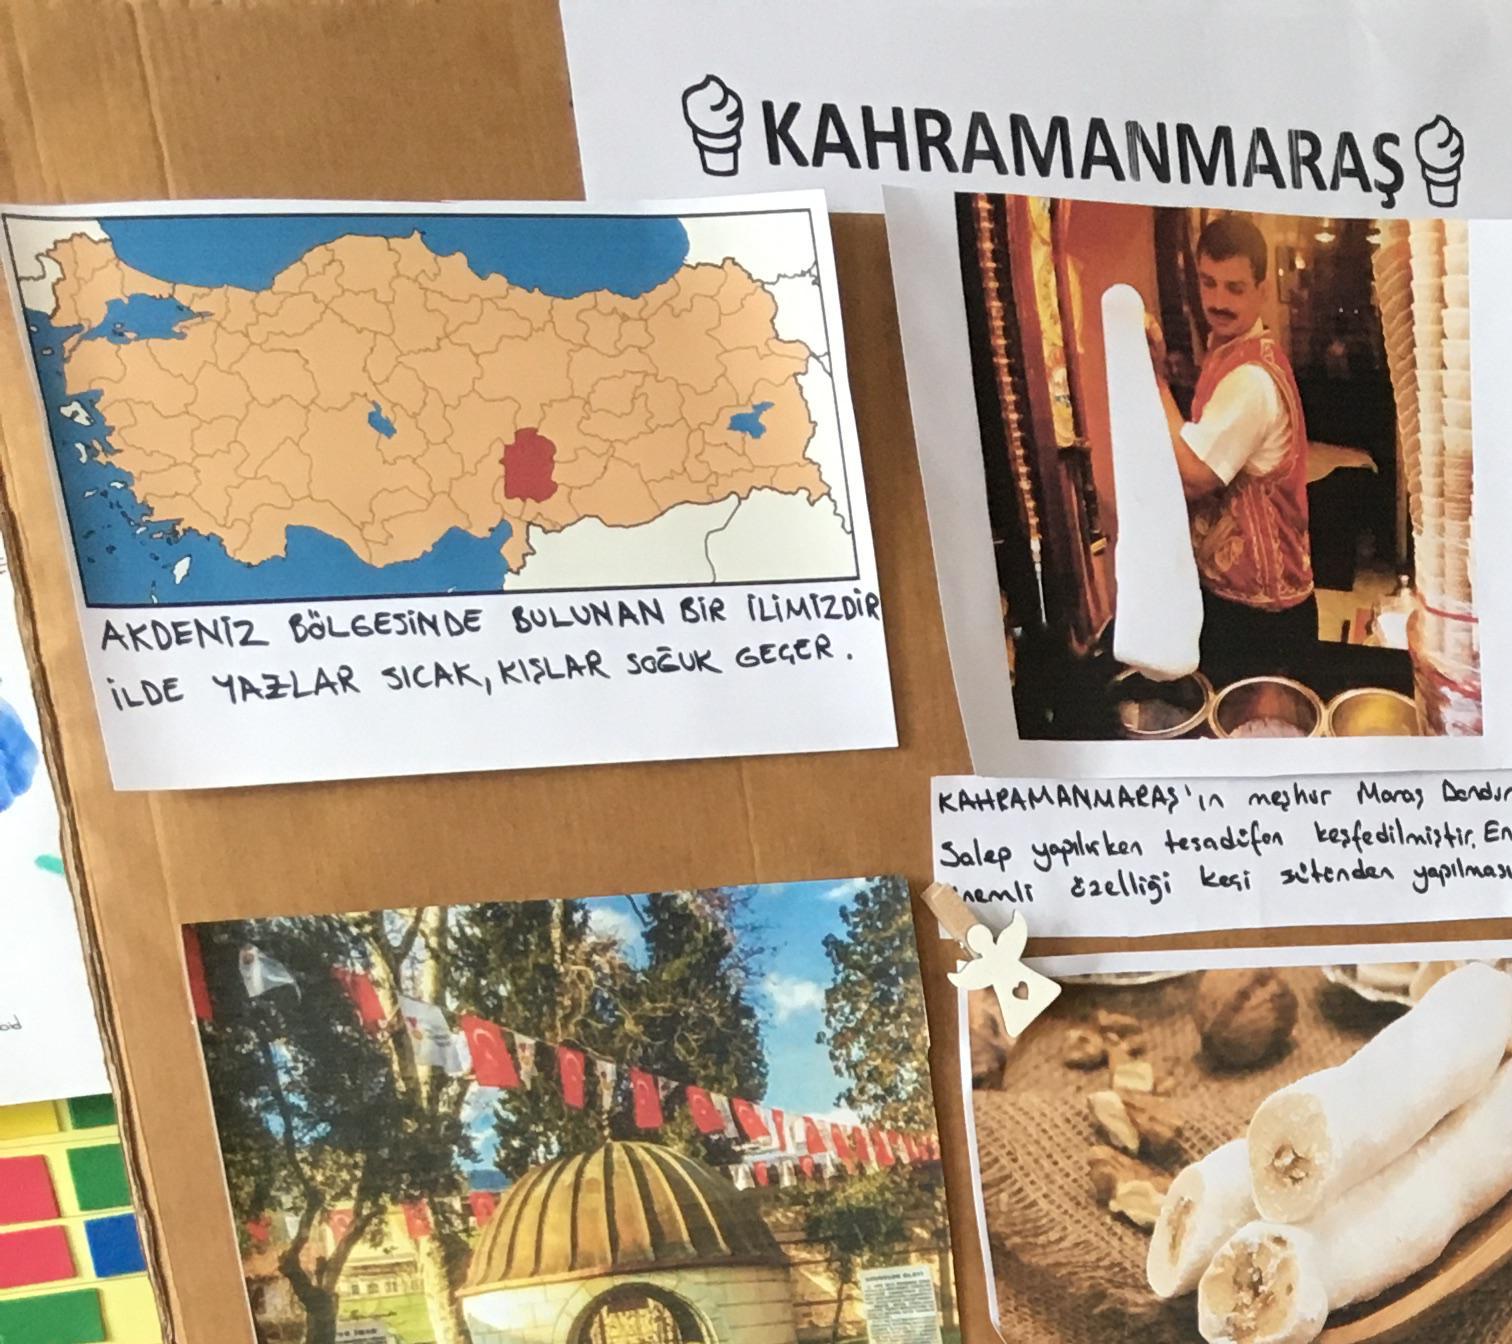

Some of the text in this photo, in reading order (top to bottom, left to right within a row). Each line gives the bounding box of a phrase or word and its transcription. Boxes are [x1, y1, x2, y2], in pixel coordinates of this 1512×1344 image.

[763, 98, 1405, 209] KAHRAMANMARAŞ
[100, 587, 881, 653] AKDENİZ BÖLGESİNDE BULUNAN BİR İLİMİZDİR
[105, 645, 723, 712] İLDE YAZLAR SICAK, KIŞLAR SOĞUK
[939, 837, 1013, 873] Salep
[951, 879, 1034, 906] nemli
